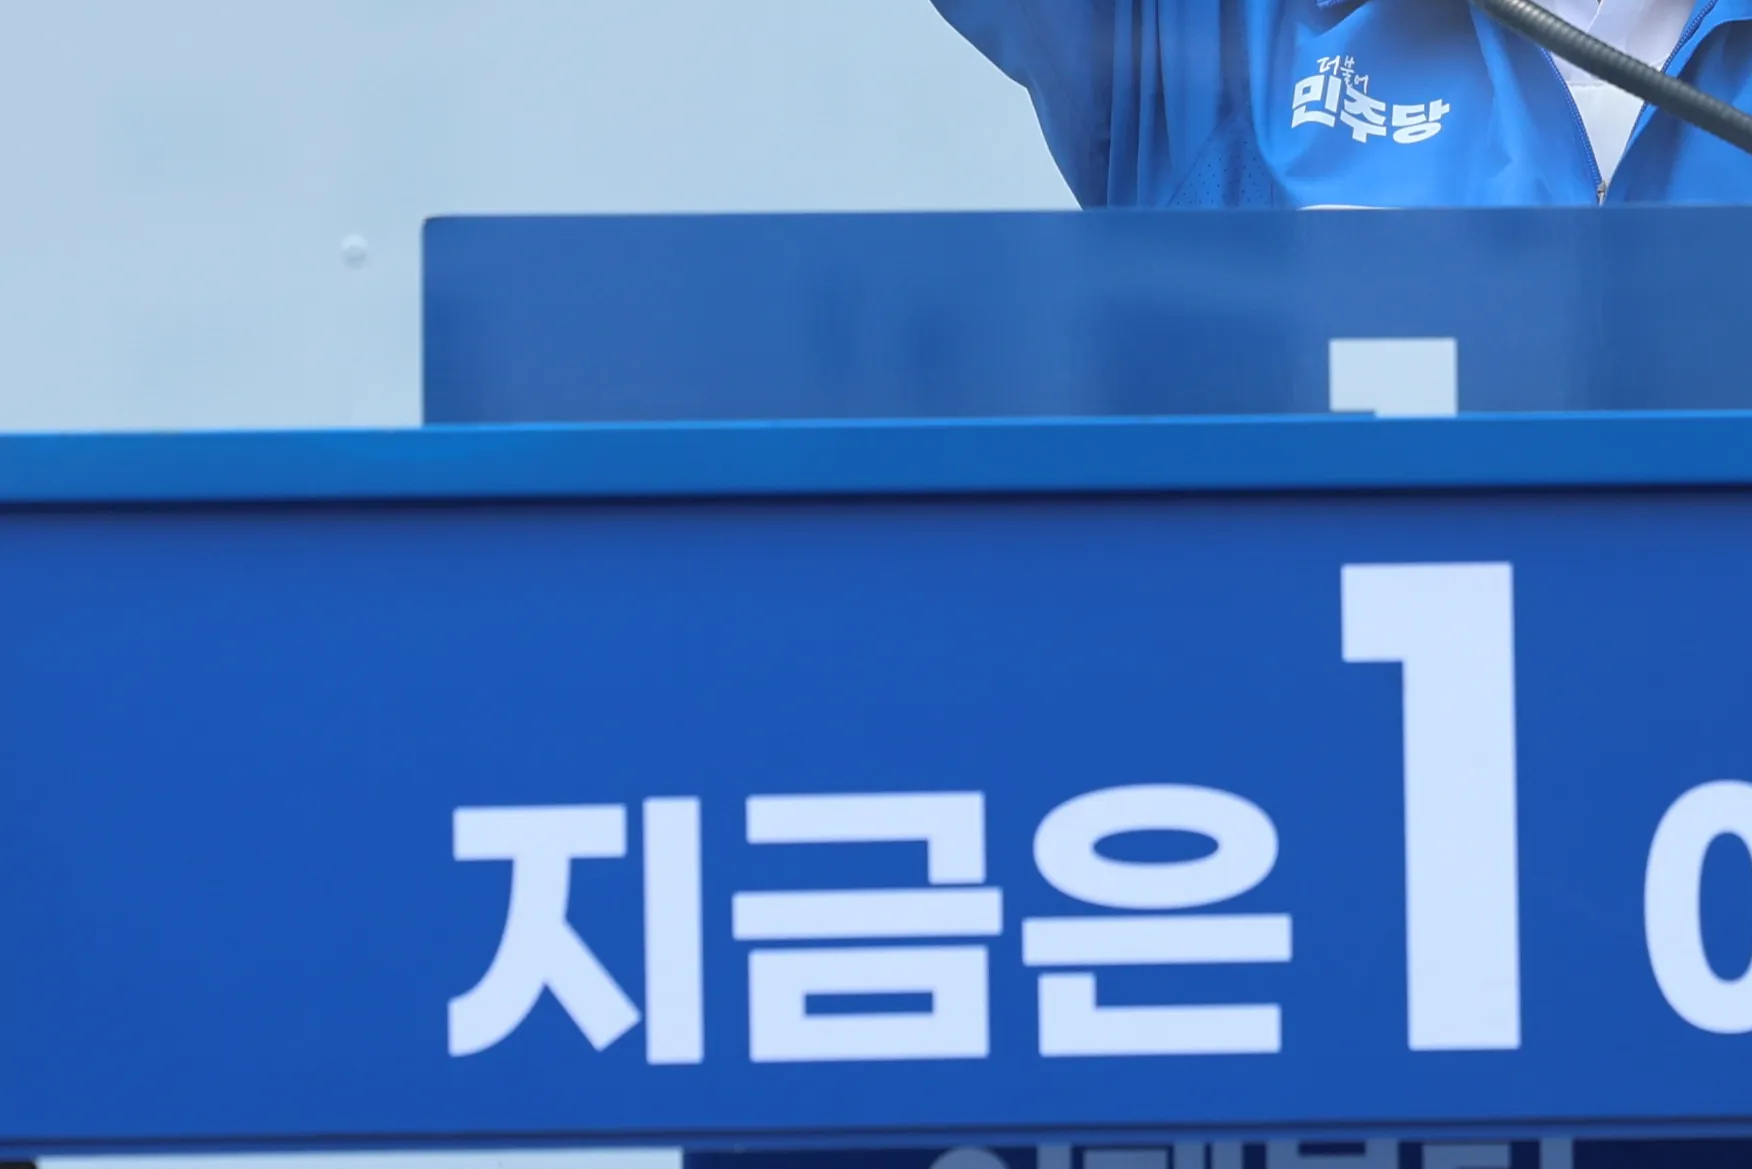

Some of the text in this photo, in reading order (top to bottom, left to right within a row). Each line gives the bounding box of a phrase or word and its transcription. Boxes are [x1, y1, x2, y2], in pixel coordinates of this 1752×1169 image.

[1291, 74, 1450, 144] 민주당
[1316, 55, 1369, 94] 더불어
[447, 783, 1293, 1065] 지금은
[1340, 561, 1522, 1051] 1
